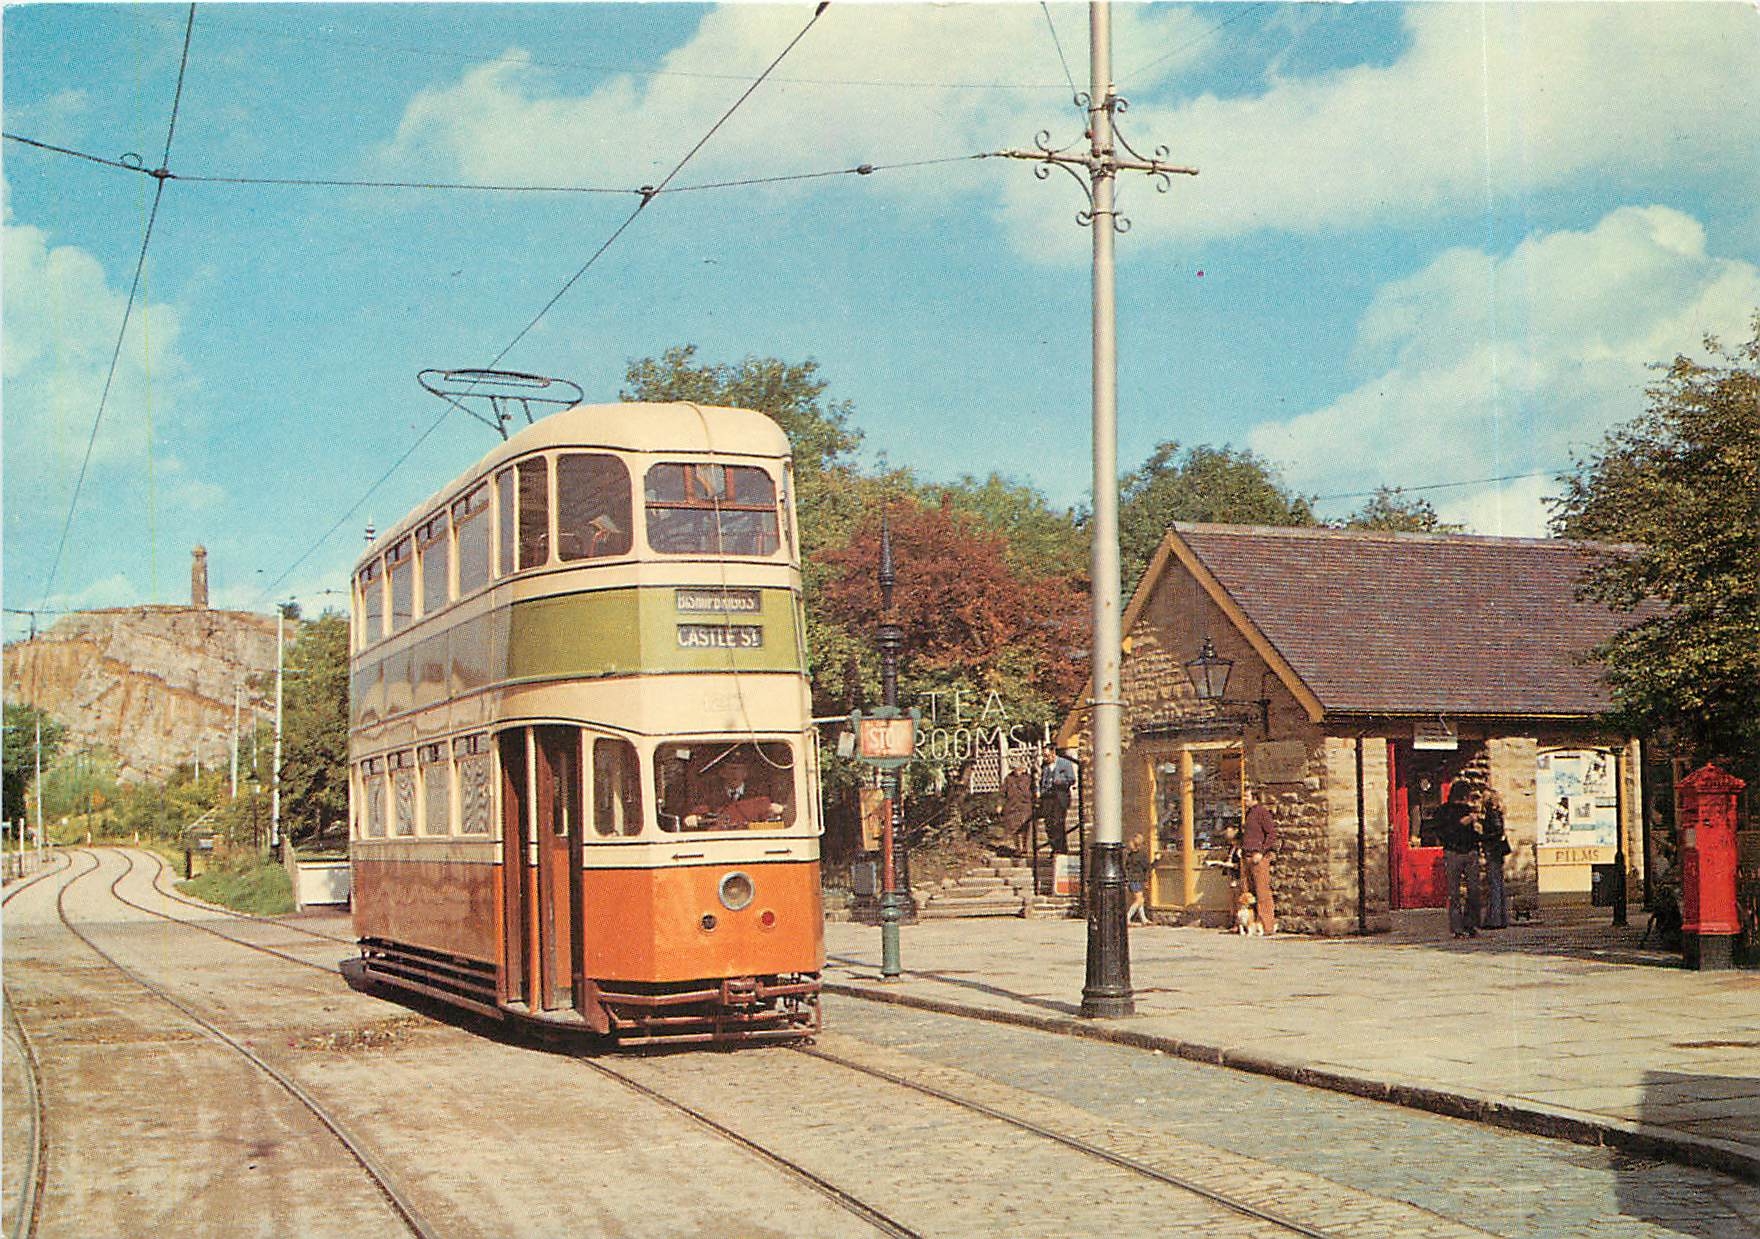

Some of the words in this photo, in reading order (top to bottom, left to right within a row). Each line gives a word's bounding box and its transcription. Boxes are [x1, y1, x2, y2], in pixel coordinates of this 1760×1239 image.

[677, 627, 737, 647] CASTLE
[917, 689, 1009, 723] TEA
[914, 725, 1026, 760] ROOMS
[1555, 848, 1600, 863] FILMS
